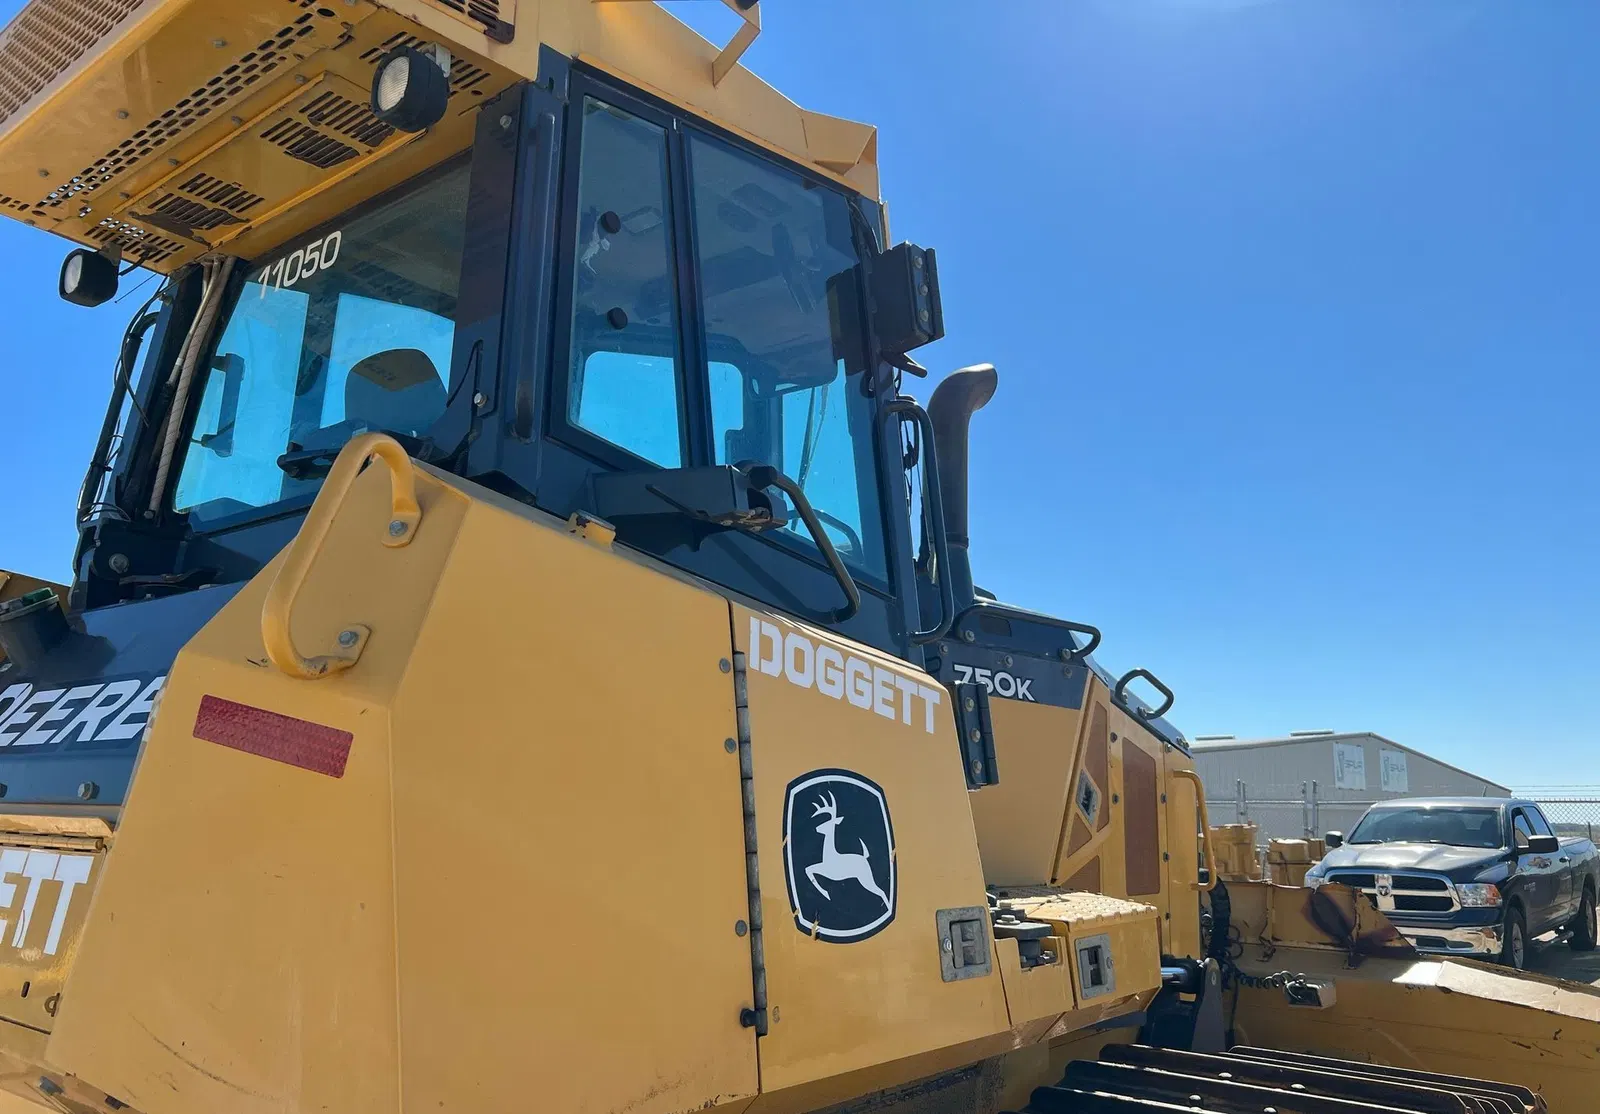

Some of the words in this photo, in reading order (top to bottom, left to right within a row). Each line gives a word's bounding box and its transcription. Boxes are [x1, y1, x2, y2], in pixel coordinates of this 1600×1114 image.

[257, 230, 342, 300] 11050
[749, 616, 941, 735] DOGGETT
[954, 664, 1035, 702] 750K
